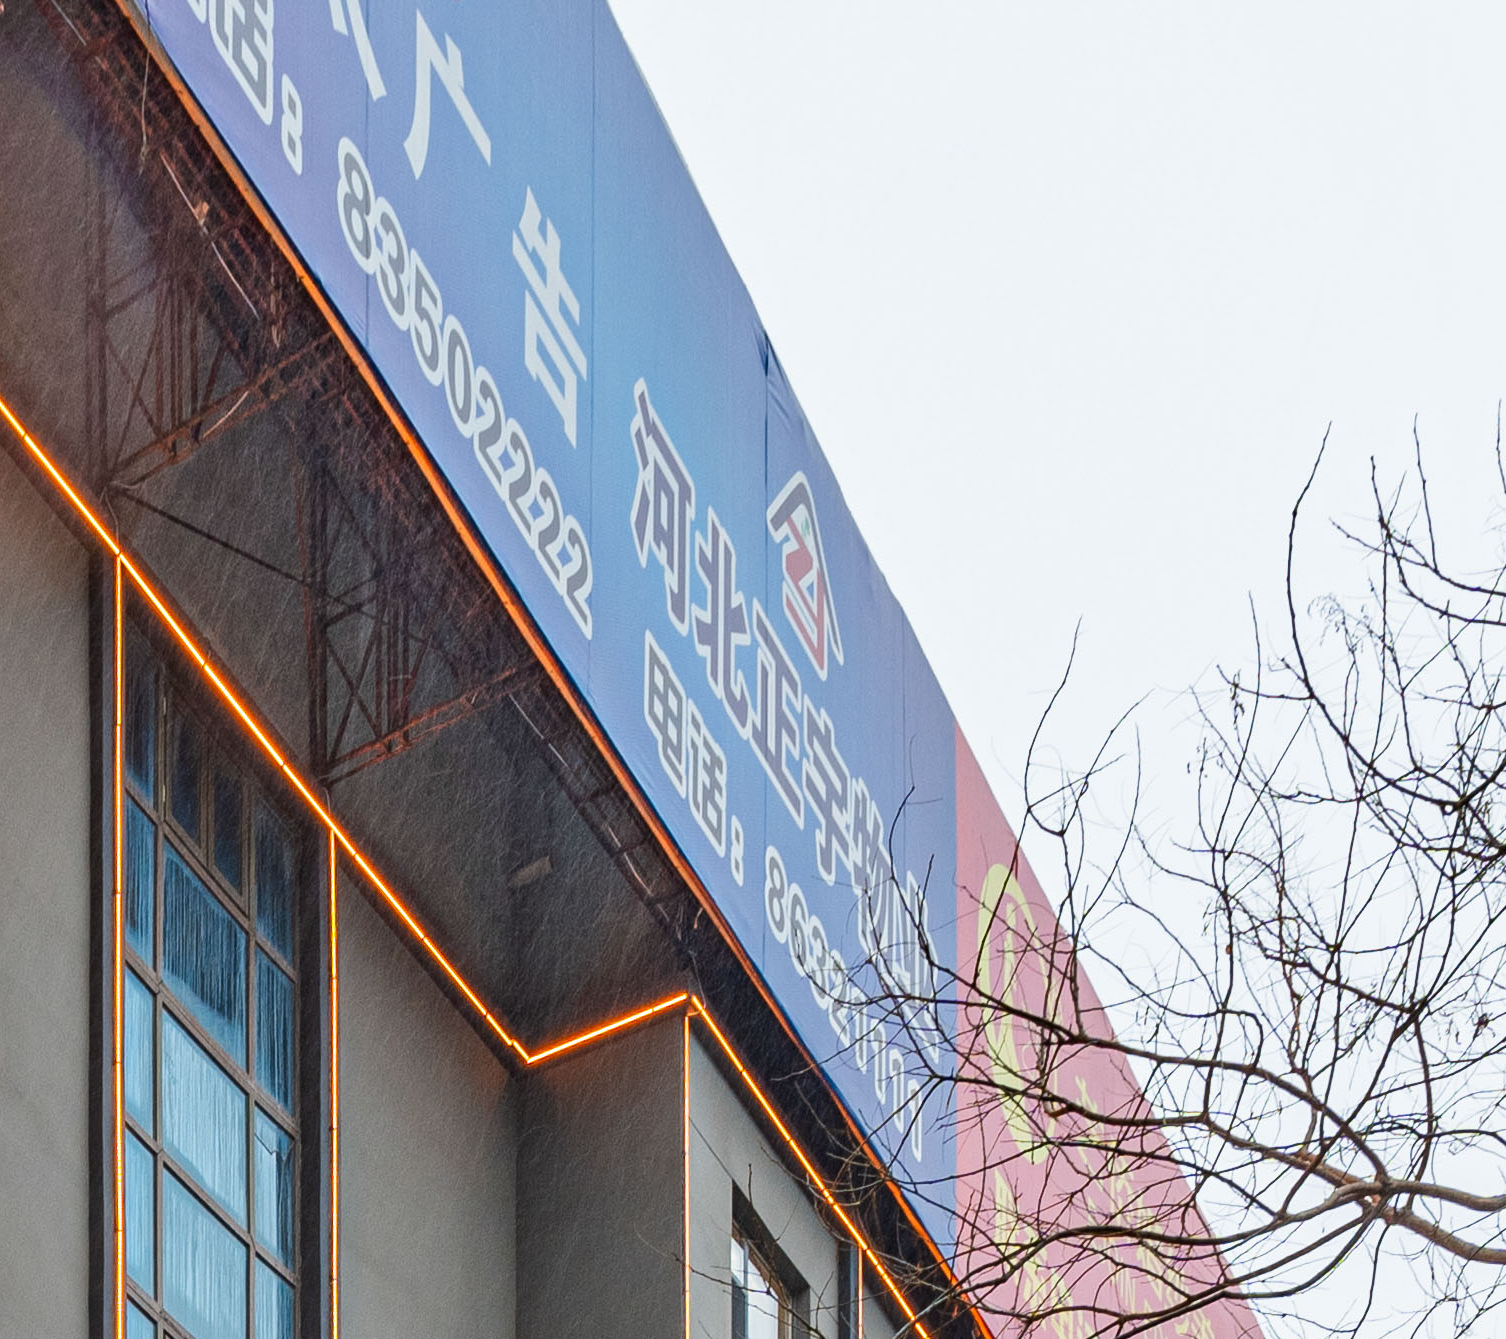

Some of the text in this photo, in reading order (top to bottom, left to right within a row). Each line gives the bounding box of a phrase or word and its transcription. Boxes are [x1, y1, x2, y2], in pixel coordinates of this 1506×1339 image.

[336, 137, 593, 640] 83502222
[630, 370, 940, 1065] 河北正宇物业
[644, 630, 922, 1163] 电话： 86321111
